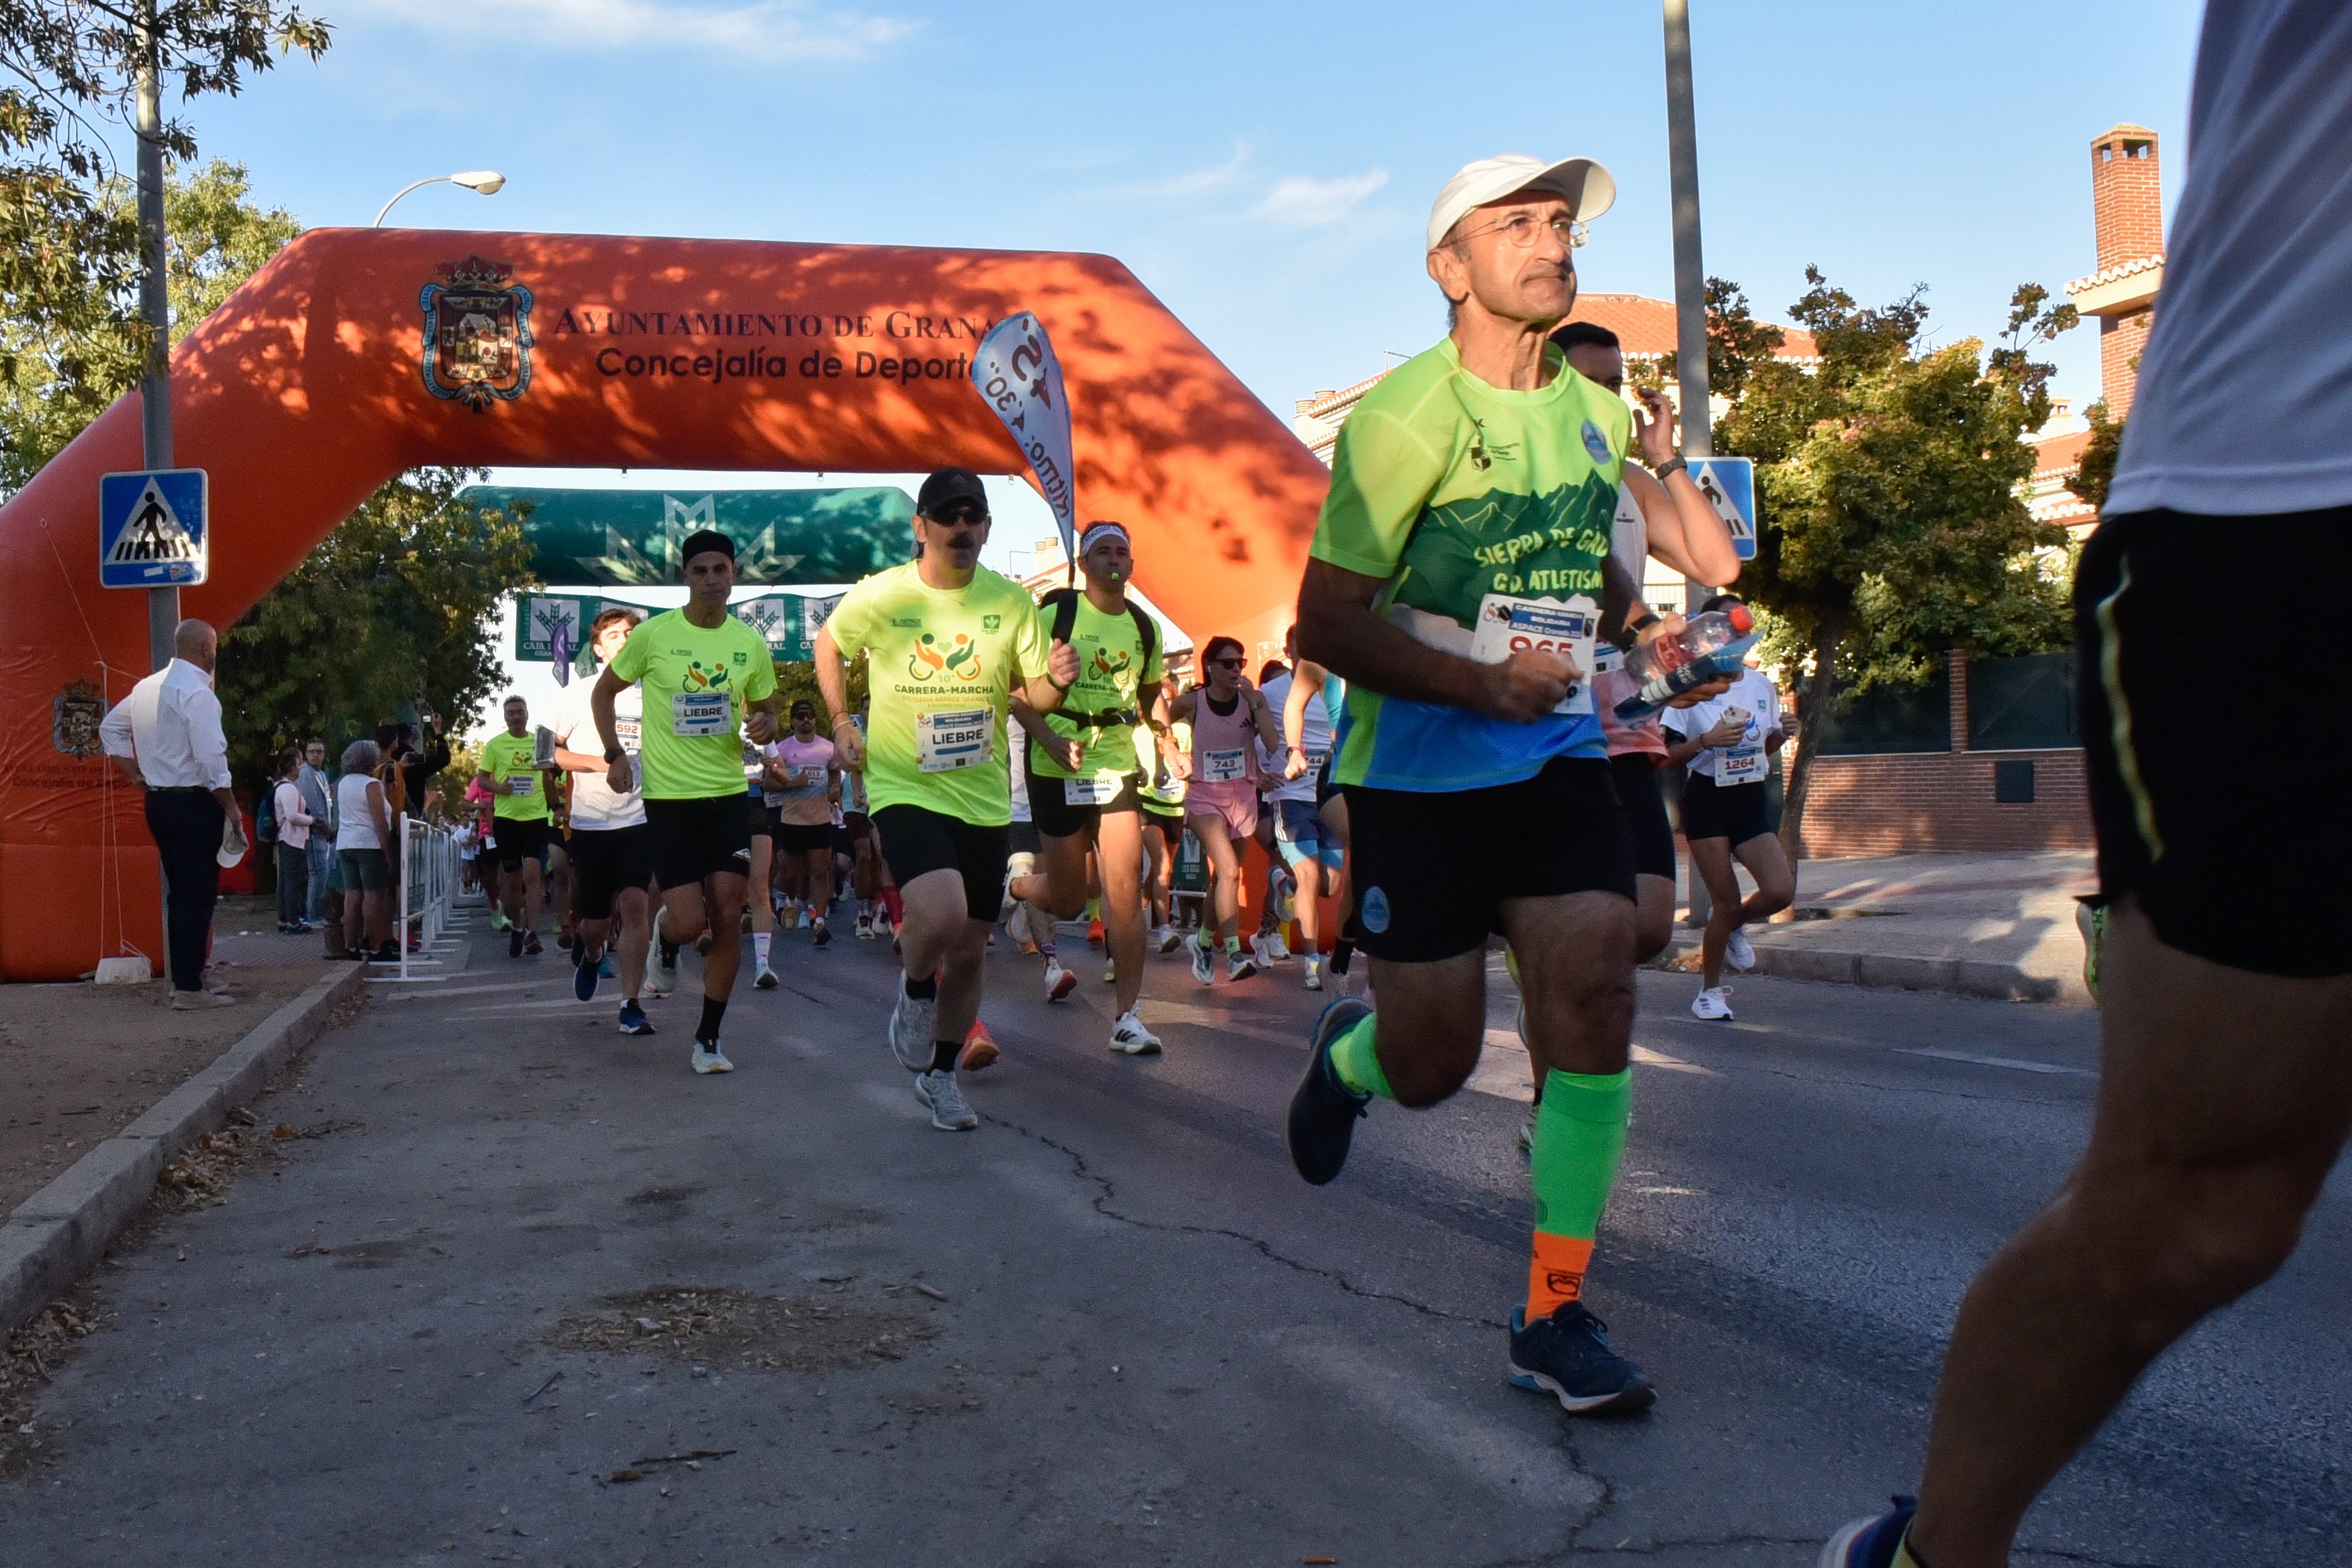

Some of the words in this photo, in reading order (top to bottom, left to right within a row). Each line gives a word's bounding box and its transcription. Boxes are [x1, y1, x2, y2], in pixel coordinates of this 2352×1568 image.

[555, 308, 823, 337] AYUNTAMIENTO
[834, 315, 874, 337] DE
[885, 311, 1003, 339] GRANA
[597, 347, 786, 383] Concejalía
[799, 350, 842, 379] de
[856, 351, 973, 385] Deport
[1528, 569, 1604, 591] ATLETISM
[894, 684, 994, 695] CARRERA-MARCHA
[683, 707, 723, 717] LIEBRE
[617, 724, 638, 734] 592
[932, 728, 984, 745] LIEBRE
[1214, 759, 1235, 768] 743
[1724, 757, 1755, 770] 1264
